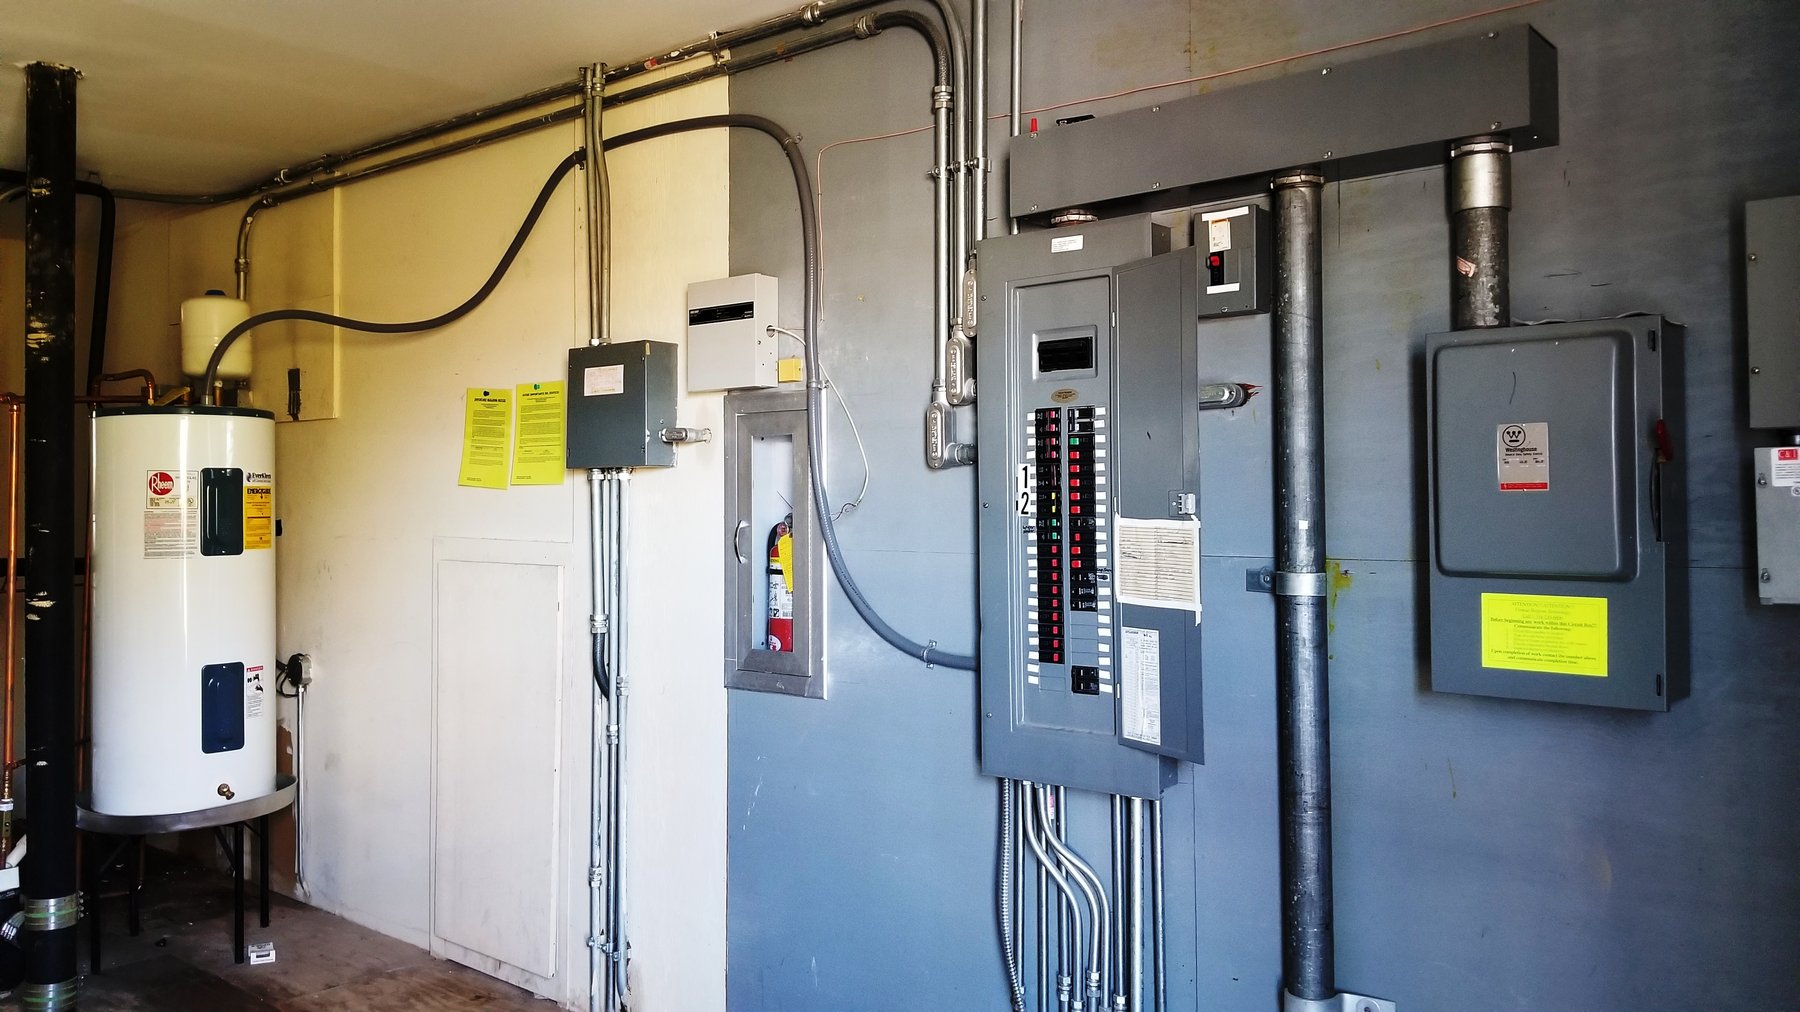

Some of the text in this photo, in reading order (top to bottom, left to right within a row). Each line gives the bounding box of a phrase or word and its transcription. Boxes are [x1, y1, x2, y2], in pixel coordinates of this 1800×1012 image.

[151, 472, 173, 493] Rheem
[1022, 465, 1028, 488] 1
[1021, 492, 1029, 515] 2
